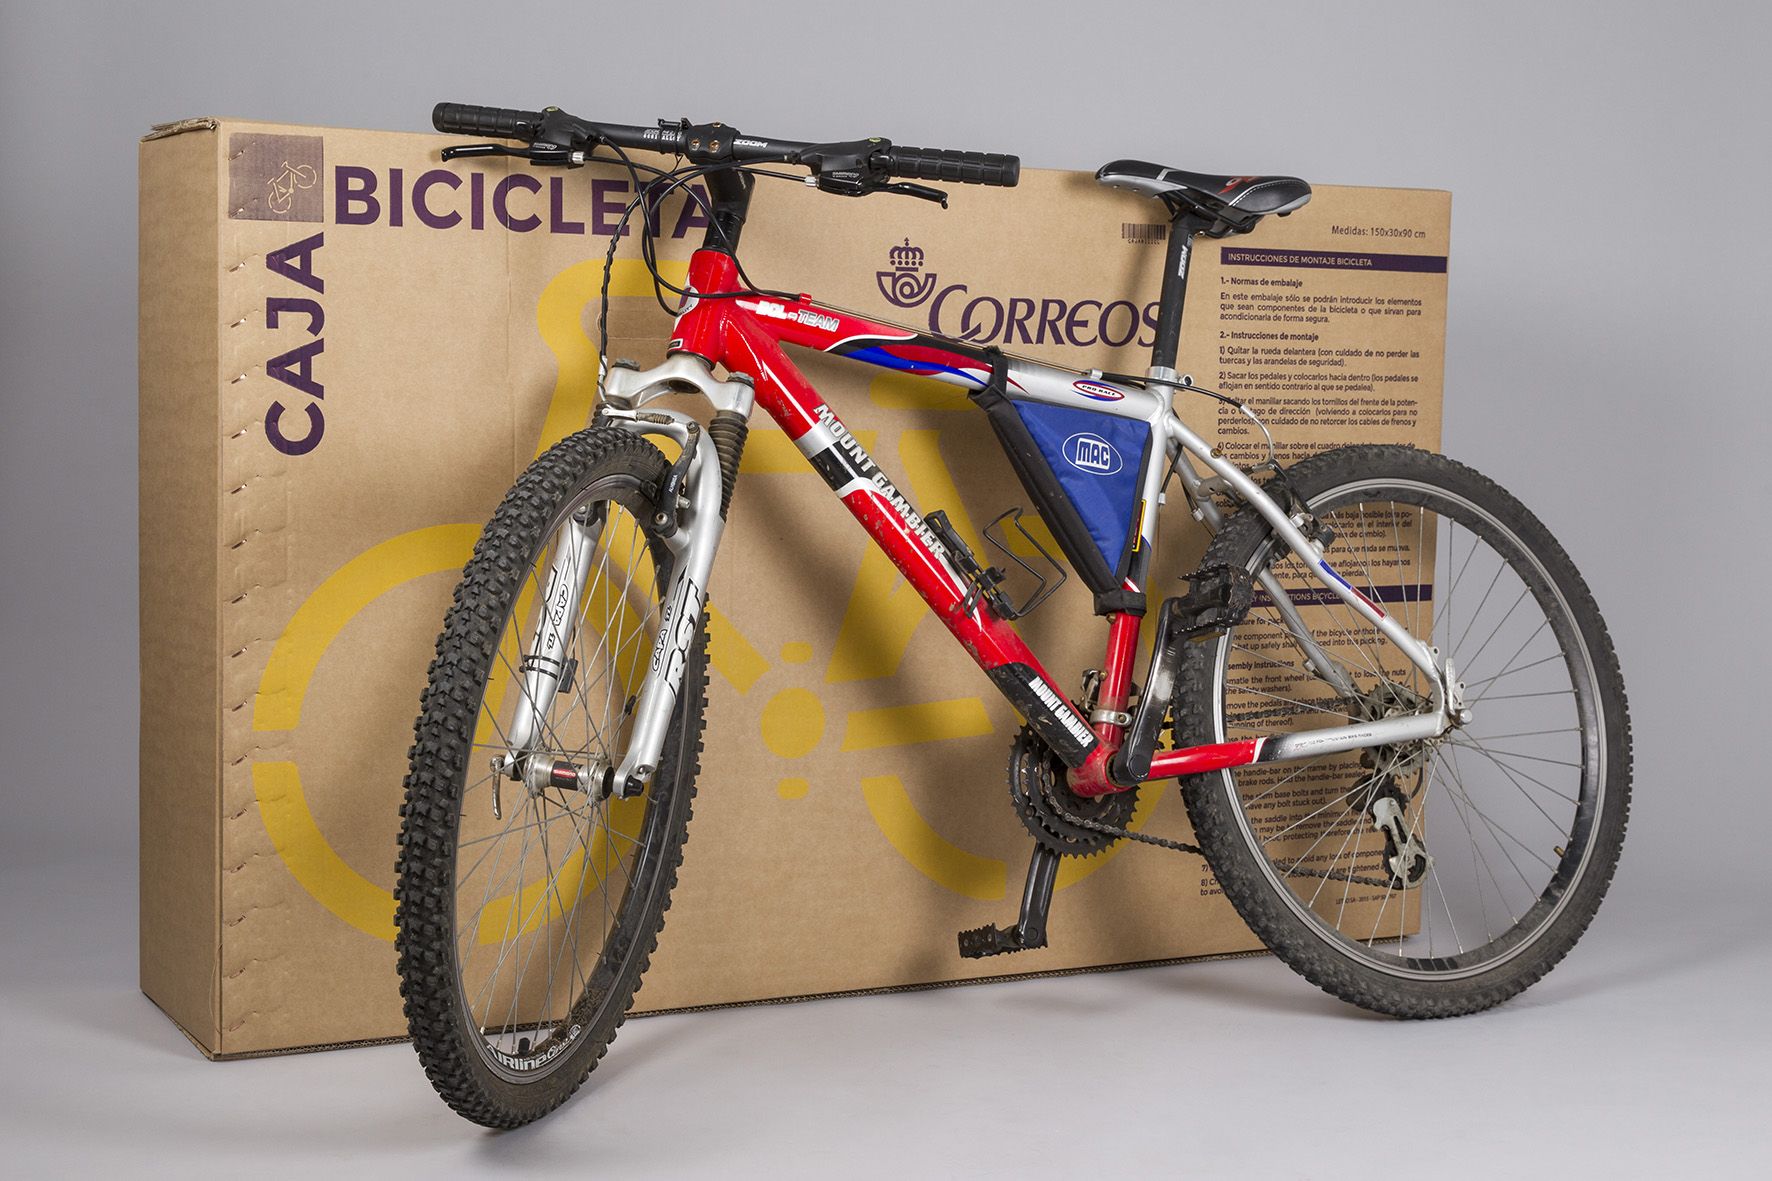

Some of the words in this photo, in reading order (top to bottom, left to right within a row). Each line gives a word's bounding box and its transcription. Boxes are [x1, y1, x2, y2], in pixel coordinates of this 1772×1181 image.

[335, 165, 713, 239] BICICLETA
[1332, 225, 1368, 236] Medidas:
[1370, 227, 1412, 238] 150x30x90
[1414, 231, 1426, 239] cm
[1228, 253, 1288, 263] INSTRUCCIONES
[1288, 255, 1299, 264] DE
[1300, 256, 1335, 265] MONTAJE
[1336, 257, 1372, 266] BICICLETA
[1230, 277, 1259, 286] Normas
[1260, 277, 1270, 286] de
[1270, 278, 1303, 289] embalaje
[1220, 292, 1230, 301] En
[1232, 292, 1248, 301] este
[1250, 293, 1283, 304] embalaje
[1340, 295, 1373, 304] introducir
[1374, 296, 1385, 305] los
[1386, 296, 1422, 306] elementos
[928, 284, 1160, 347] CORREOS
[1220, 304, 1234, 312] que
[1256, 303, 1305, 314] componentes
[1308, 304, 1318, 313] de
[1320, 304, 1326, 313] la
[1328, 305, 1358, 314] bicicleta
[1368, 308, 1382, 316] que
[1384, 306, 1404, 315] sirvan
[1406, 309, 1422, 318] para
[797, 308, 840, 332] TEAM
[1220, 312, 1271, 322] acondicionarla
[1272, 313, 1282, 322] de
[1282, 313, 1304, 322] forma
[1306, 316, 1330, 325] segura.
[265, 231, 325, 456] CAJA
[1230, 331, 1278, 340] Instrucciones
[1280, 332, 1289, 340] de
[1290, 332, 1319, 343] montaje
[1226, 346, 1250, 355] Quitar
[1252, 346, 1258, 355] la
[1260, 347, 1281, 356] rueda
[1282, 347, 1316, 356] delantera
[1318, 348, 1334, 358] (con
[1334, 348, 1362, 357] cuidado
[1364, 349, 1374, 357] de
[1386, 349, 1409, 360] perder
[1410, 350, 1420, 358] las
[1220, 356, 1246, 365] tuercas
[1253, 357, 1262, 365] las
[1264, 357, 1297, 366] arandelas
[1298, 357, 1307, 366] de
[1227, 371, 1247, 380] Sacar
[1248, 371, 1258, 380] los
[1260, 371, 1287, 382] pedales
[1293, 372, 1328, 381] colocarlos
[1348, 373, 1370, 382] dentro
[1372, 373, 1383, 384] (los
[1385, 374, 1410, 384] pedales
[1218, 381, 1243, 392] aflojan
[1254, 382, 1281, 390] sentido
[1282, 382, 1313, 391] contrario
[1314, 382, 1320, 391] al
[1320, 384, 1335, 393] que
[1248, 397, 1255, 405] el
[1256, 397, 1282, 405] manillar
[1283, 397, 1310, 406] sacando
[1312, 397, 1321, 406] los
[1322, 397, 1348, 406] tornillos
[1349, 398, 1359, 406] del
[1360, 398, 1379, 406] frente
[1380, 398, 1389, 407] de
[1390, 398, 1396, 407] la
[1268, 407, 1277, 415] de
[1315, 407, 1350, 418] (volviendo
[1358, 407, 1391, 416] colocarlos
[1393, 410, 1407, 418] para
[1271, 417, 1299, 425] cuidado
[1300, 417, 1309, 425] de
[1320, 417, 1347, 425] retorcer
[1348, 417, 1358, 426] los
[1359, 417, 1380, 426] cables
[1381, 417, 1390, 426] de
[1391, 417, 1411, 426] frenos
[1218, 426, 1250, 435] cambios.
[1225, 441, 1252, 449] Colocar
[1253, 441, 1260, 450] el
[1290, 441, 1309, 450] sobre
[1310, 441, 1316, 450] el
[1077, 441, 1109, 466] MAC
[1230, 451, 1259, 460] cambios
[813, 403, 876, 472] MOUNT
[872, 472, 945, 559] GAMBIER
[1243, 632, 1283, 642] component
[1028, 675, 1062, 712] MOUNT
